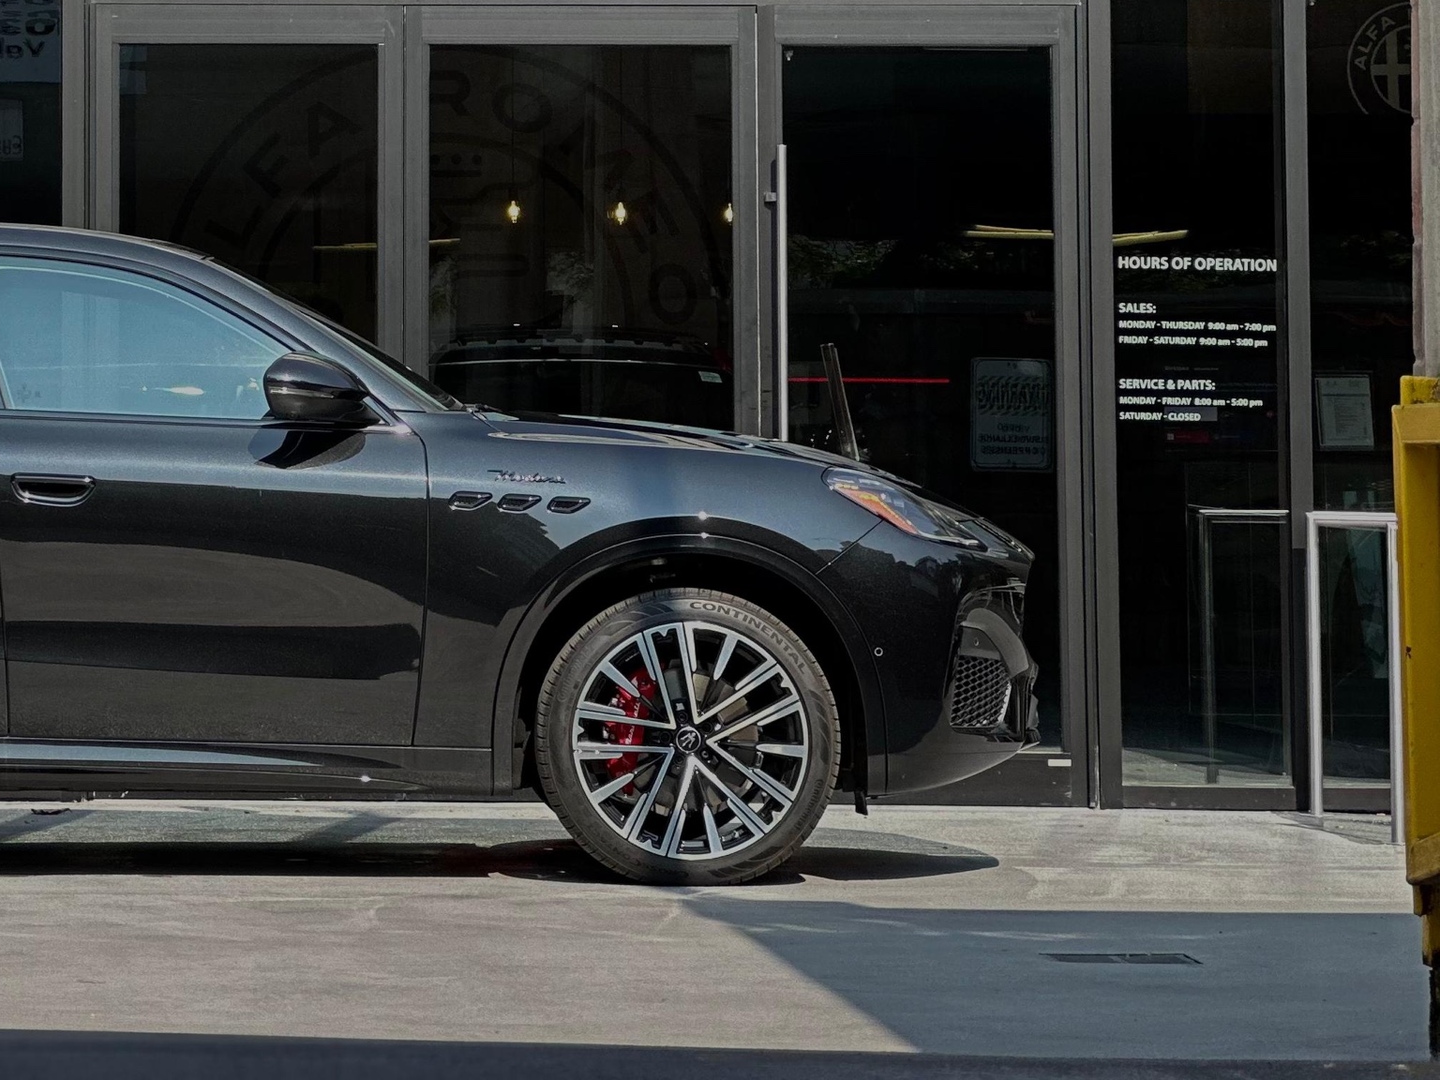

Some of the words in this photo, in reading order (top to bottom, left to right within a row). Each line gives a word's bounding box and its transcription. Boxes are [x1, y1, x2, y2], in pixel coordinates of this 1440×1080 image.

[1354, 16, 1396, 70] ALFA
[205, 100, 361, 251] LFA
[1117, 256, 1169, 270] HOURS
[1171, 257, 1192, 270] OF
[1194, 257, 1278, 272] OPERATION
[1118, 302, 1157, 314] SALES:
[1118, 320, 1156, 330] MONDAY
[1161, 321, 1206, 330] THURSDAY
[1207, 322, 1226, 331] 9:00
[1226, 323, 1239, 331] am
[1244, 322, 1262, 332] 7:00
[1262, 324, 1277, 333] pm
[1118, 336, 1148, 344] FRIDAY
[1153, 336, 1197, 345] SATURDAY
[1199, 337, 1217, 346] 9:00
[1236, 338, 1254, 347] 5:00
[1254, 340, 1268, 348] pm
[1118, 378, 1166, 390] SERVICE
[1166, 379, 1176, 390] &
[1177, 379, 1216, 391] PARTS:
[1119, 396, 1157, 405] MONDAY
[1162, 397, 1192, 406] FRIDAY
[1231, 398, 1249, 407] 5:00
[1249, 400, 1264, 408] pm
[1119, 411, 1163, 421] SATURDAY
[1167, 412, 1202, 421] CLOSED
[689, 601, 807, 675] CONTINENTAL
